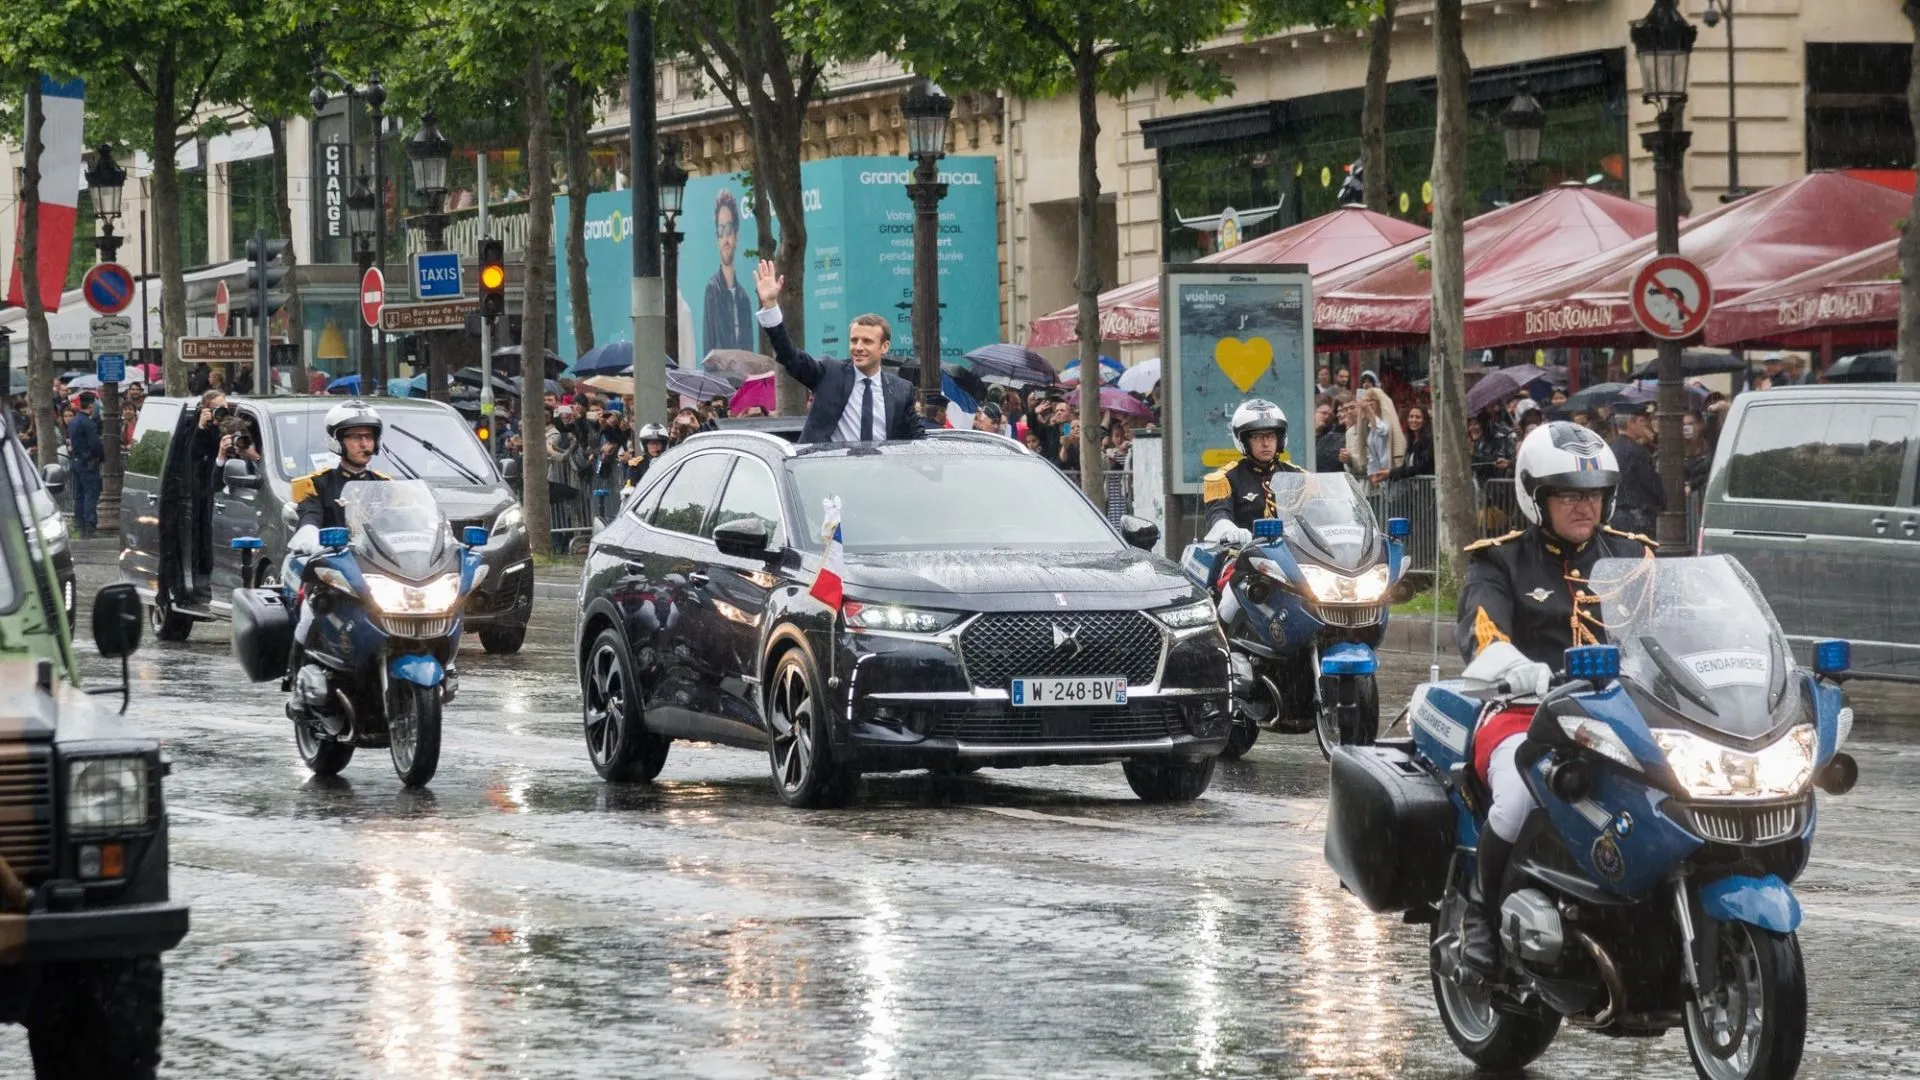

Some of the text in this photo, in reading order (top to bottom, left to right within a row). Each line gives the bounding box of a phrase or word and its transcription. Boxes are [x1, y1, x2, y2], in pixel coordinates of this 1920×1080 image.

[860, 170, 982, 185] Grandtical
[326, 145, 341, 236] CHANGE
[885, 210, 912, 221] Votre
[420, 267, 457, 281] TAXIS
[1185, 290, 1226, 305] vueling
[412, 308, 440, 317] Bureau
[442, 305, 452, 314] de
[1562, 304, 1613, 330] ROMAIN
[427, 315, 441, 325] Rue
[444, 315, 465, 323] Balz
[1695, 656, 1765, 674] GENDARMERIE
[1116, 693, 1126, 702] 75
